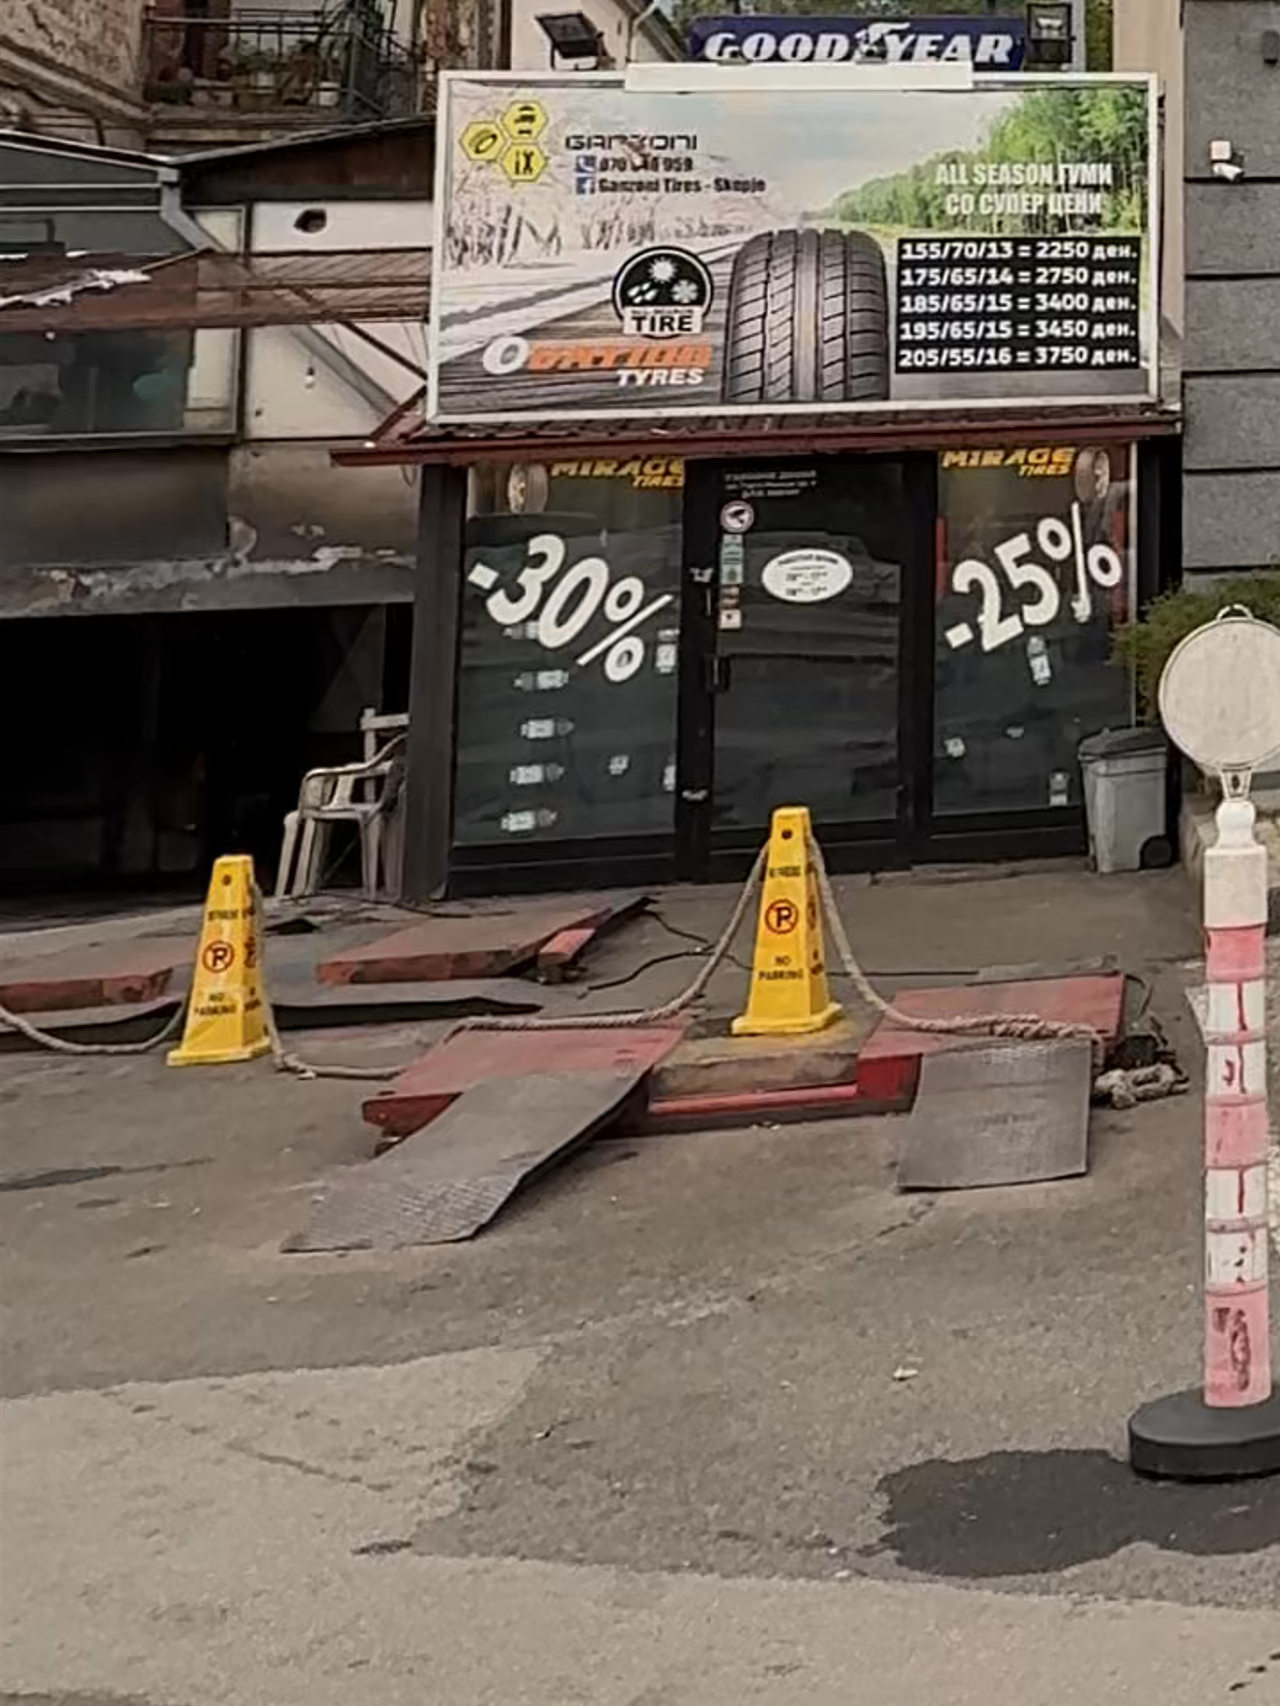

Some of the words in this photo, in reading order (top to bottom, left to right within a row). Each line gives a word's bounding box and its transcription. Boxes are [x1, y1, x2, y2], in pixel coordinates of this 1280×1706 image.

[935, 164, 970, 186] ALL
[973, 163, 1053, 186] SEASON
[901, 242, 1013, 260] 155/70/13
[1035, 242, 1089, 259] 2250
[900, 268, 1013, 286] 175/65/14
[1035, 268, 1089, 284] 2750
[900, 295, 1013, 313] 185/65/15
[1035, 294, 1088, 311] 3400
[632, 315, 693, 332] TIRE
[900, 321, 1012, 340] 195/65/15
[1035, 321, 1088, 337] 3450
[899, 348, 1011, 367] 205/55/16
[1034, 347, 1088, 364] 3750
[616, 368, 703, 385] TYRES
[942, 447, 1077, 469] MIRAGE
[1018, 463, 1072, 476] TIRES
[944, 503, 1122, 652] -25%
[467, 534, 677, 682] -30%
